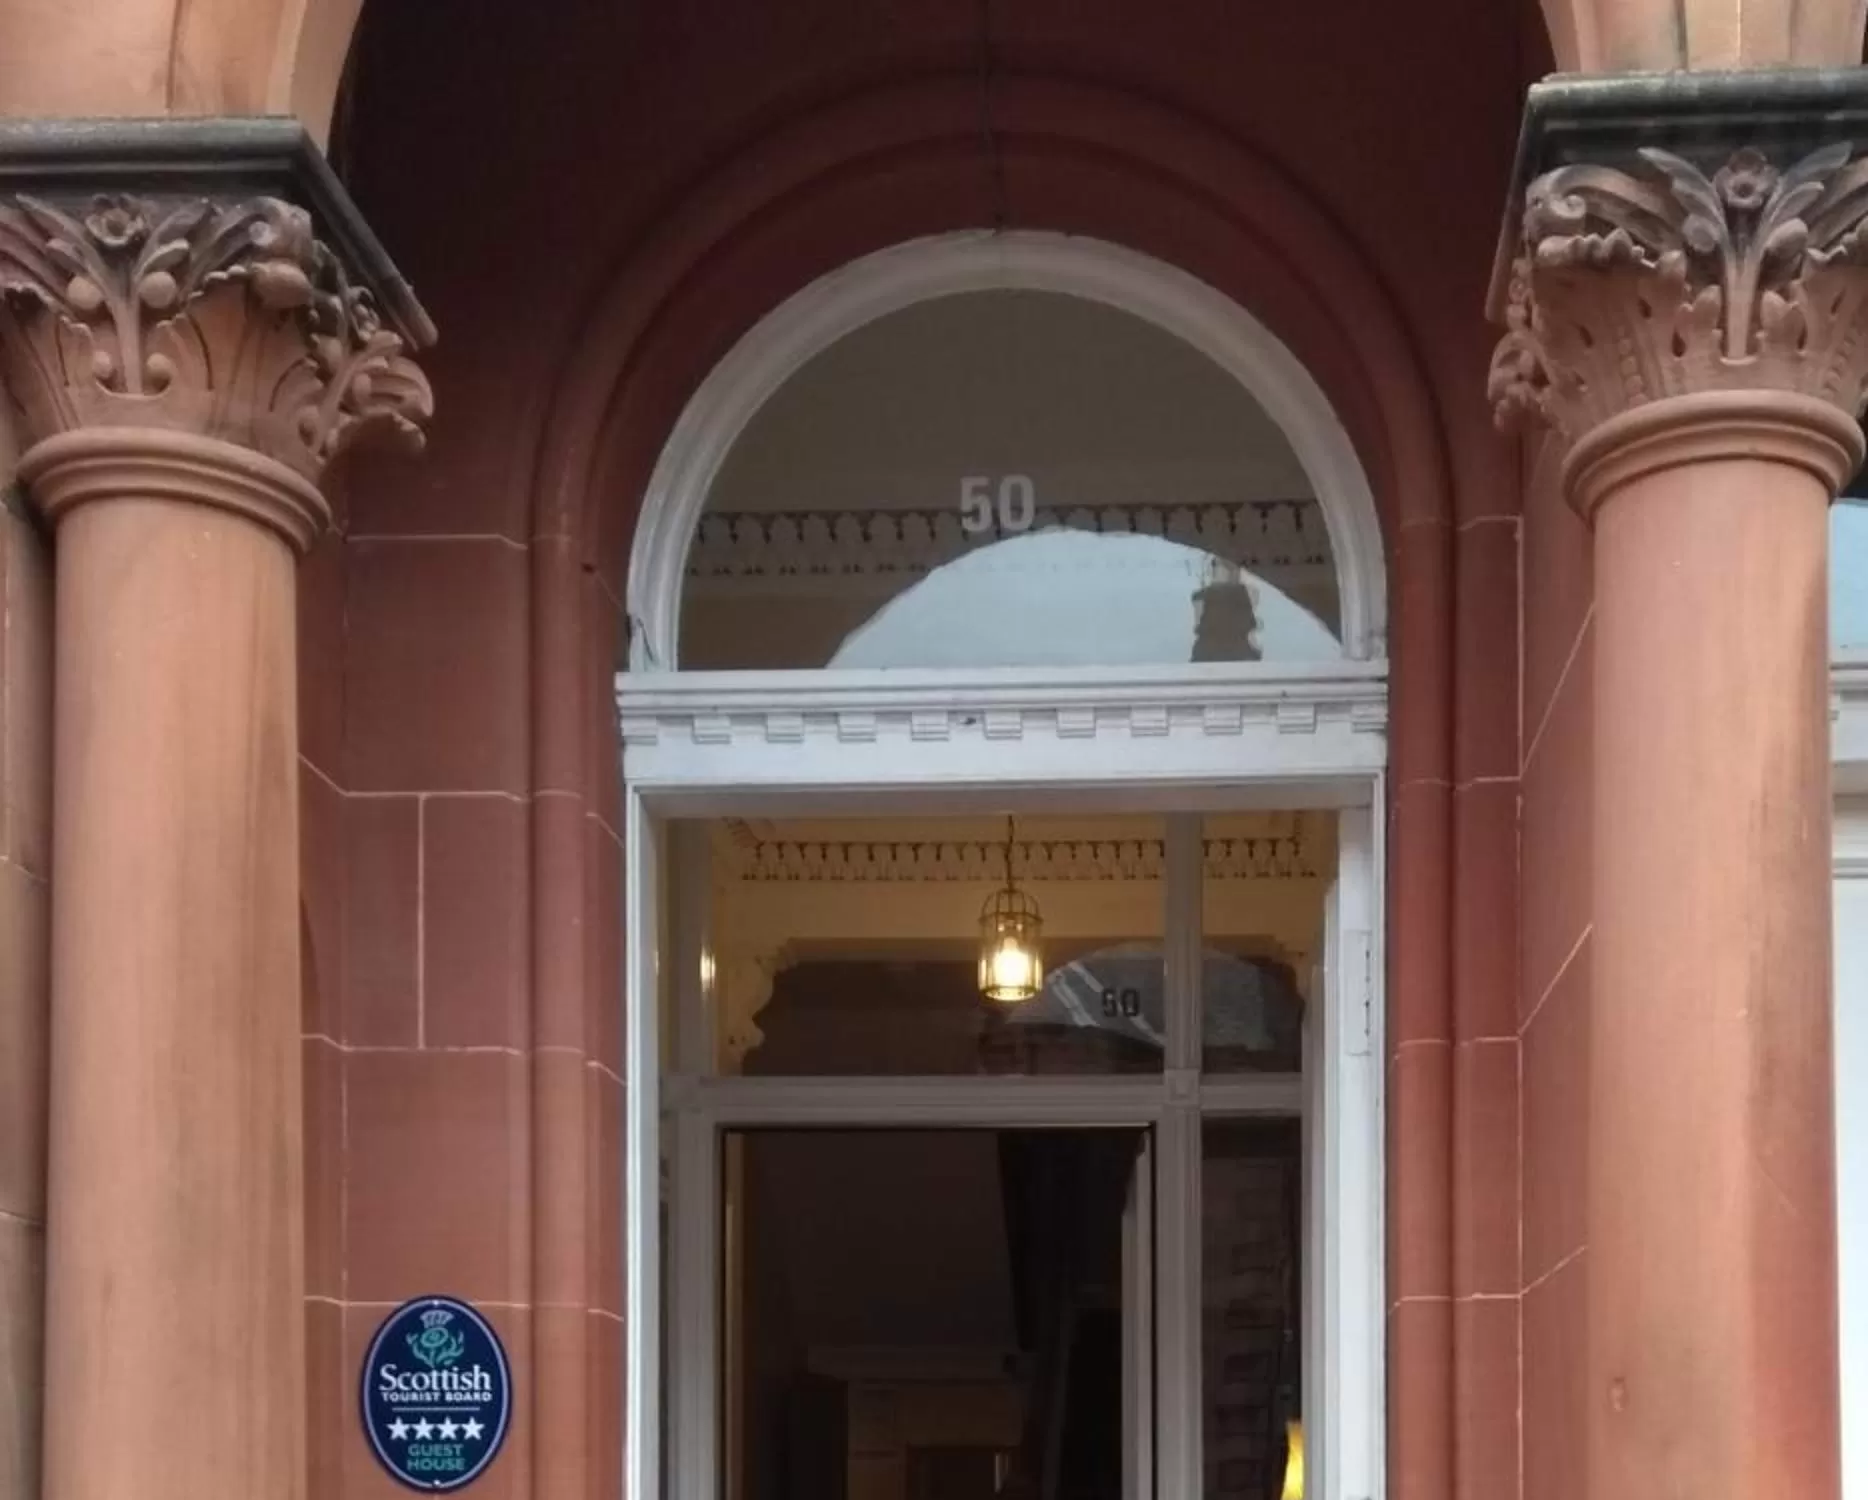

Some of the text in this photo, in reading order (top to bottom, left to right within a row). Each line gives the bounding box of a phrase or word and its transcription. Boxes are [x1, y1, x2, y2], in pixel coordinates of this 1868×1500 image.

[961, 475, 1035, 532] 50
[379, 1363, 492, 1391] Scottish
[381, 1392, 493, 1402] TOURIST BOARD
[408, 1444, 463, 1457] GUEST
[407, 1457, 465, 1471] HOUSE
